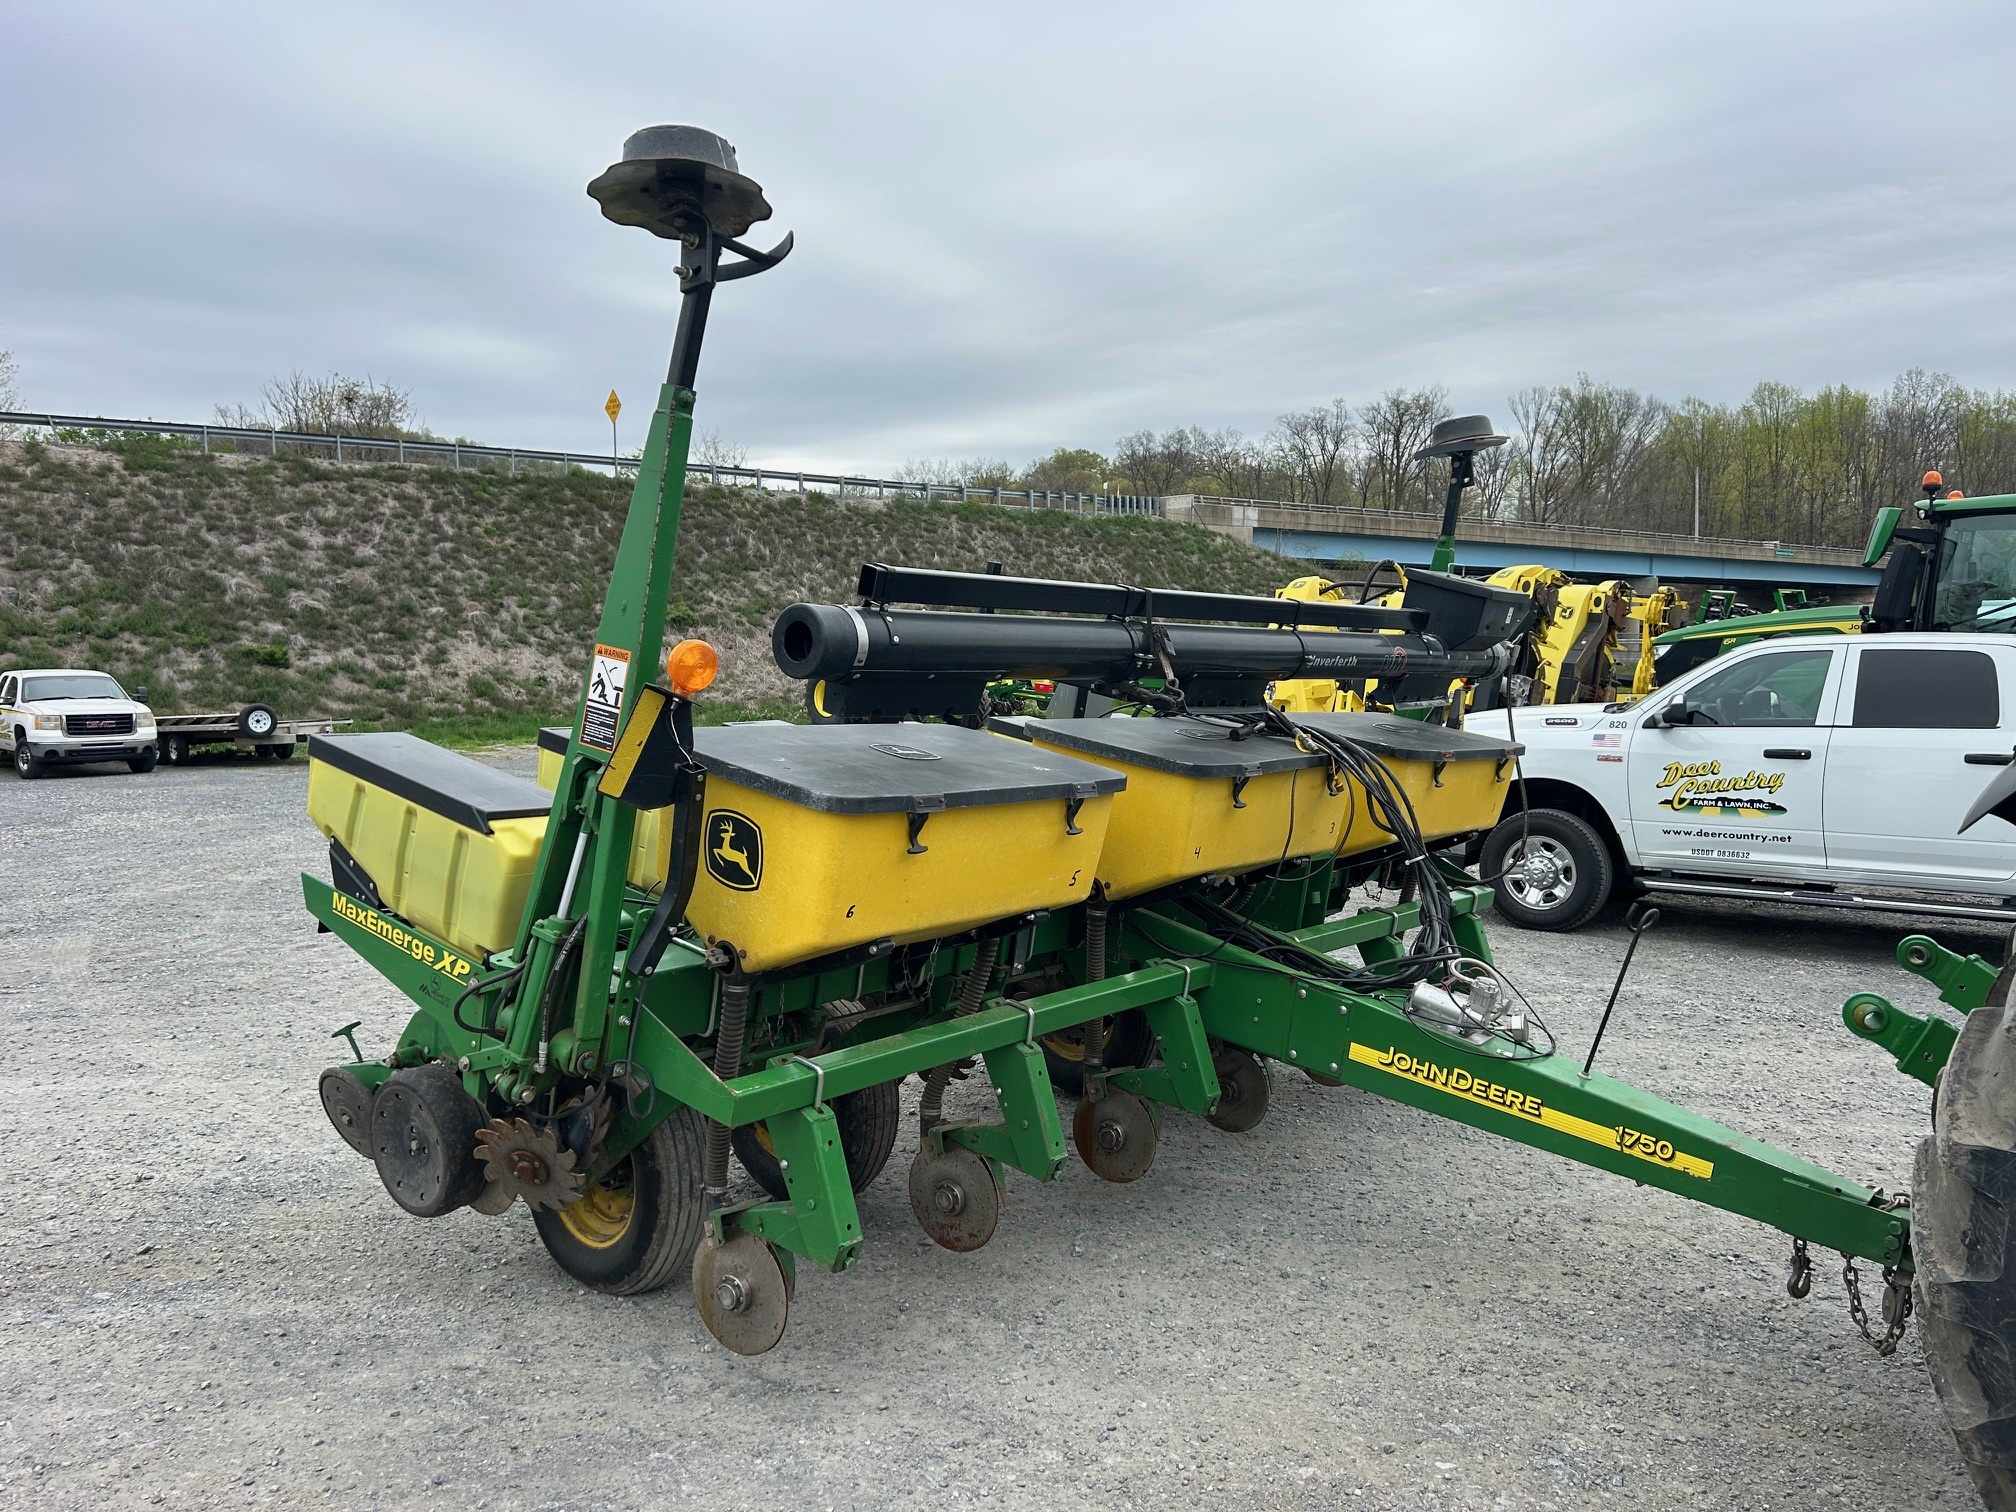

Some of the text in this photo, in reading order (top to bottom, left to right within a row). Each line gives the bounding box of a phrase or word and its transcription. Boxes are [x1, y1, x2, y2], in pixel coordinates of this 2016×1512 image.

[1723, 637, 1737, 645] 6R
[603, 647, 629, 661] WARNING
[1609, 720, 1628, 729] 820
[1656, 760, 1721, 788] Deer
[1671, 770, 1786, 810] Country
[1693, 799, 1716, 807] FARM
[1753, 802, 1772, 810] INC.
[1329, 821, 1336, 835] 3
[1662, 828, 1793, 843] www.deercountry.net
[1194, 845, 1202, 860] 4
[1691, 848, 1715, 857] USDOT
[1068, 869, 1082, 887] 5
[845, 904, 856, 919] 6
[332, 890, 471, 978] MaxEmerge XP
[1378, 1046, 1543, 1118] JOHN DEERE
[1614, 1125, 1676, 1163] 1750
